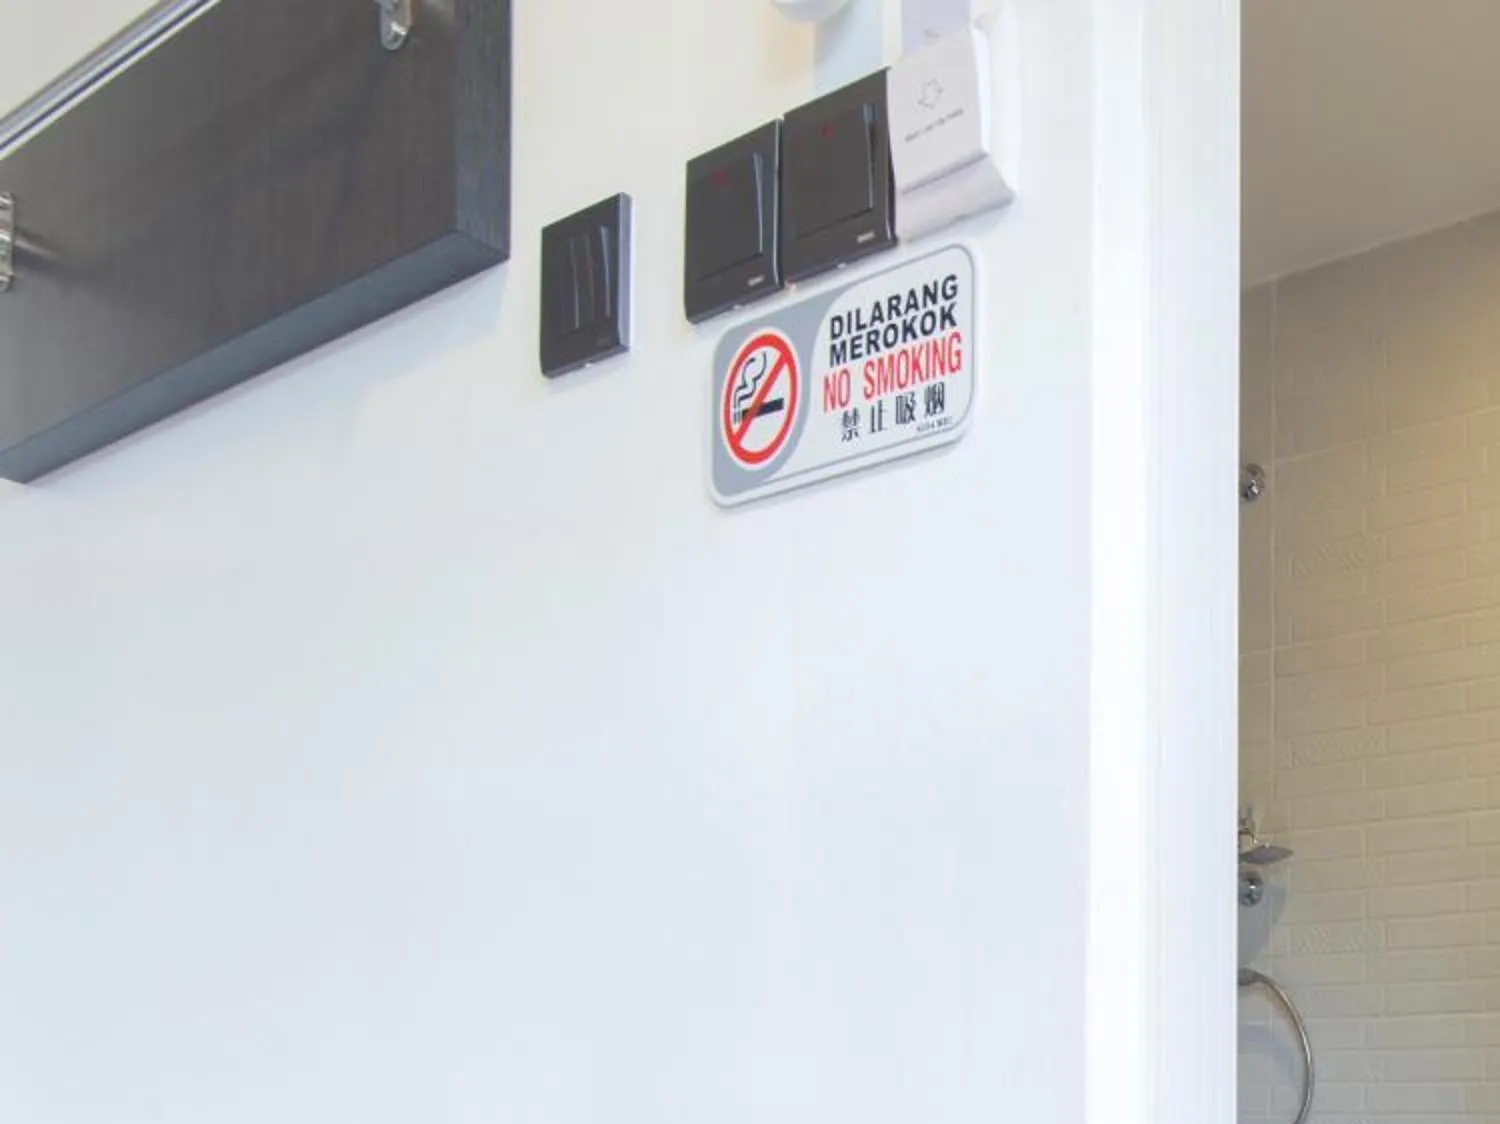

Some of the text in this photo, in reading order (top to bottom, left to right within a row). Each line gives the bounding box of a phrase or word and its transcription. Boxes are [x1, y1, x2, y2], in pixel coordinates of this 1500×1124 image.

[829, 303, 957, 368] MEROKOK
[830, 274, 958, 340] DILARANG
[823, 332, 961, 413] NO SMOKING
